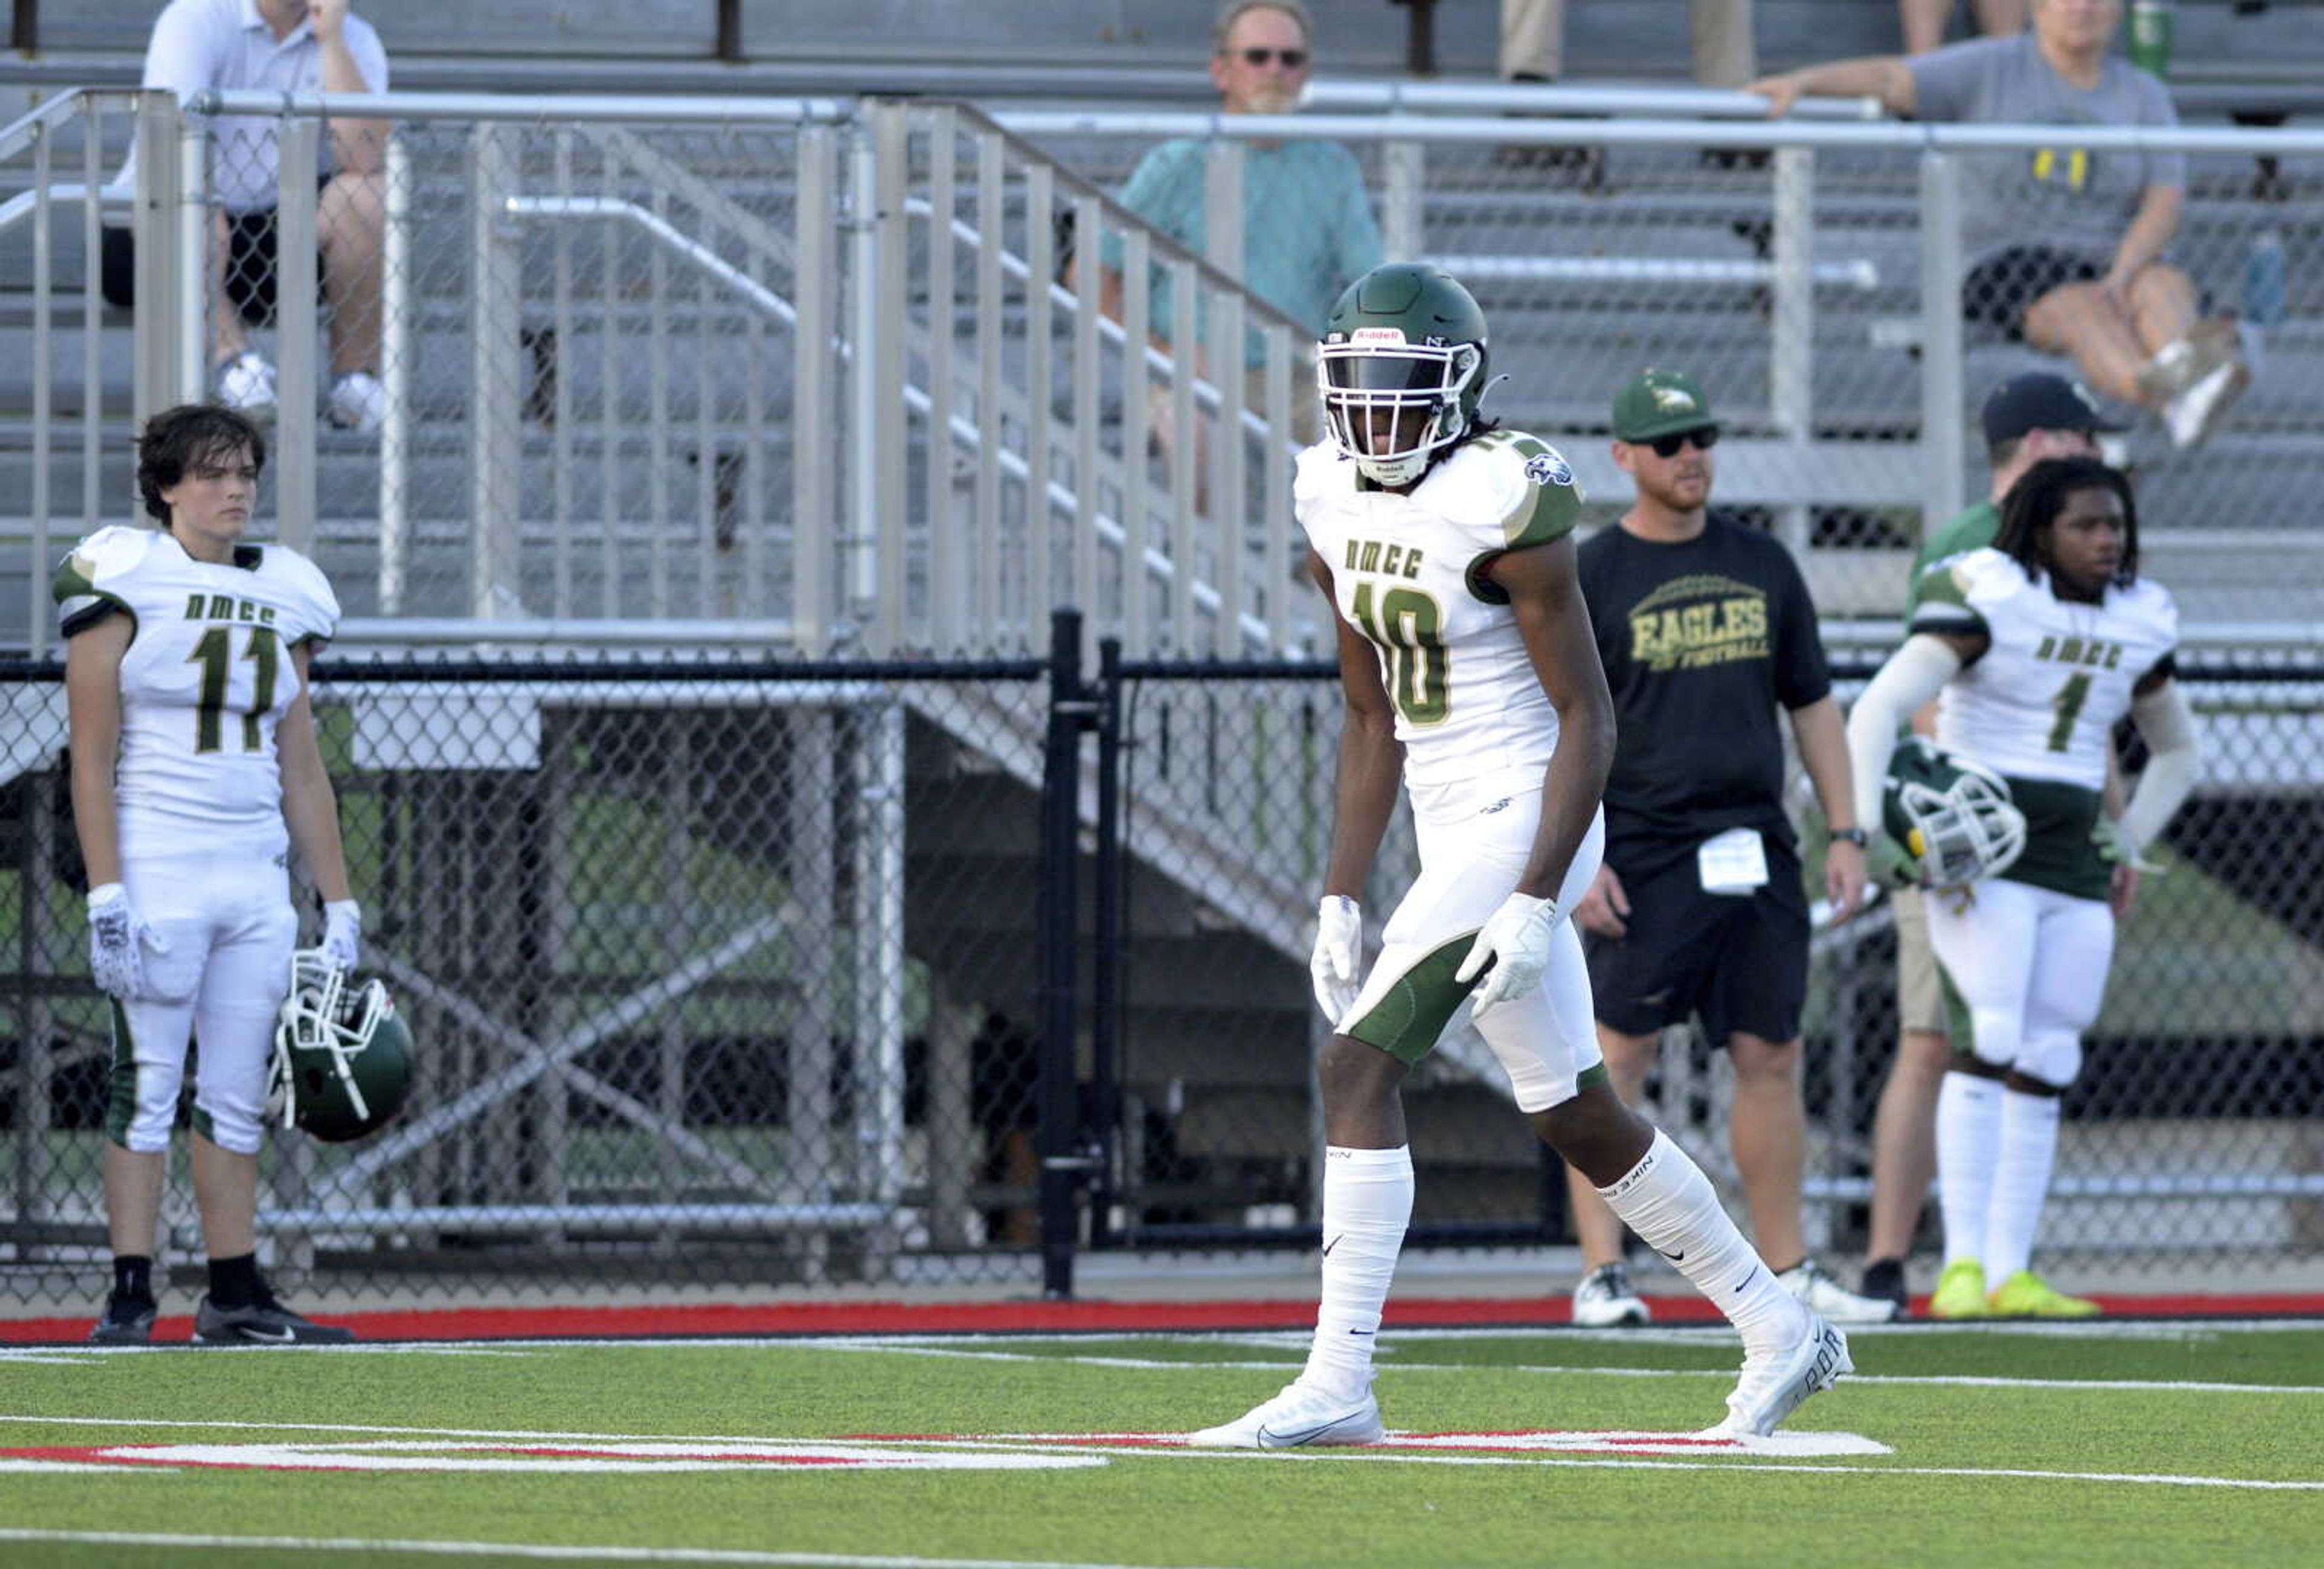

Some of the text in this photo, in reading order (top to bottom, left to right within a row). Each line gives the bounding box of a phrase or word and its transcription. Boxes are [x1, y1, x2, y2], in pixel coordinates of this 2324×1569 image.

[1351, 581, 1452, 729] 10
[1632, 597, 1768, 661] EAGLES
[185, 625, 278, 754] 11
[2047, 671, 2092, 751] 1
[1620, 1155, 1653, 1191] NIKE
